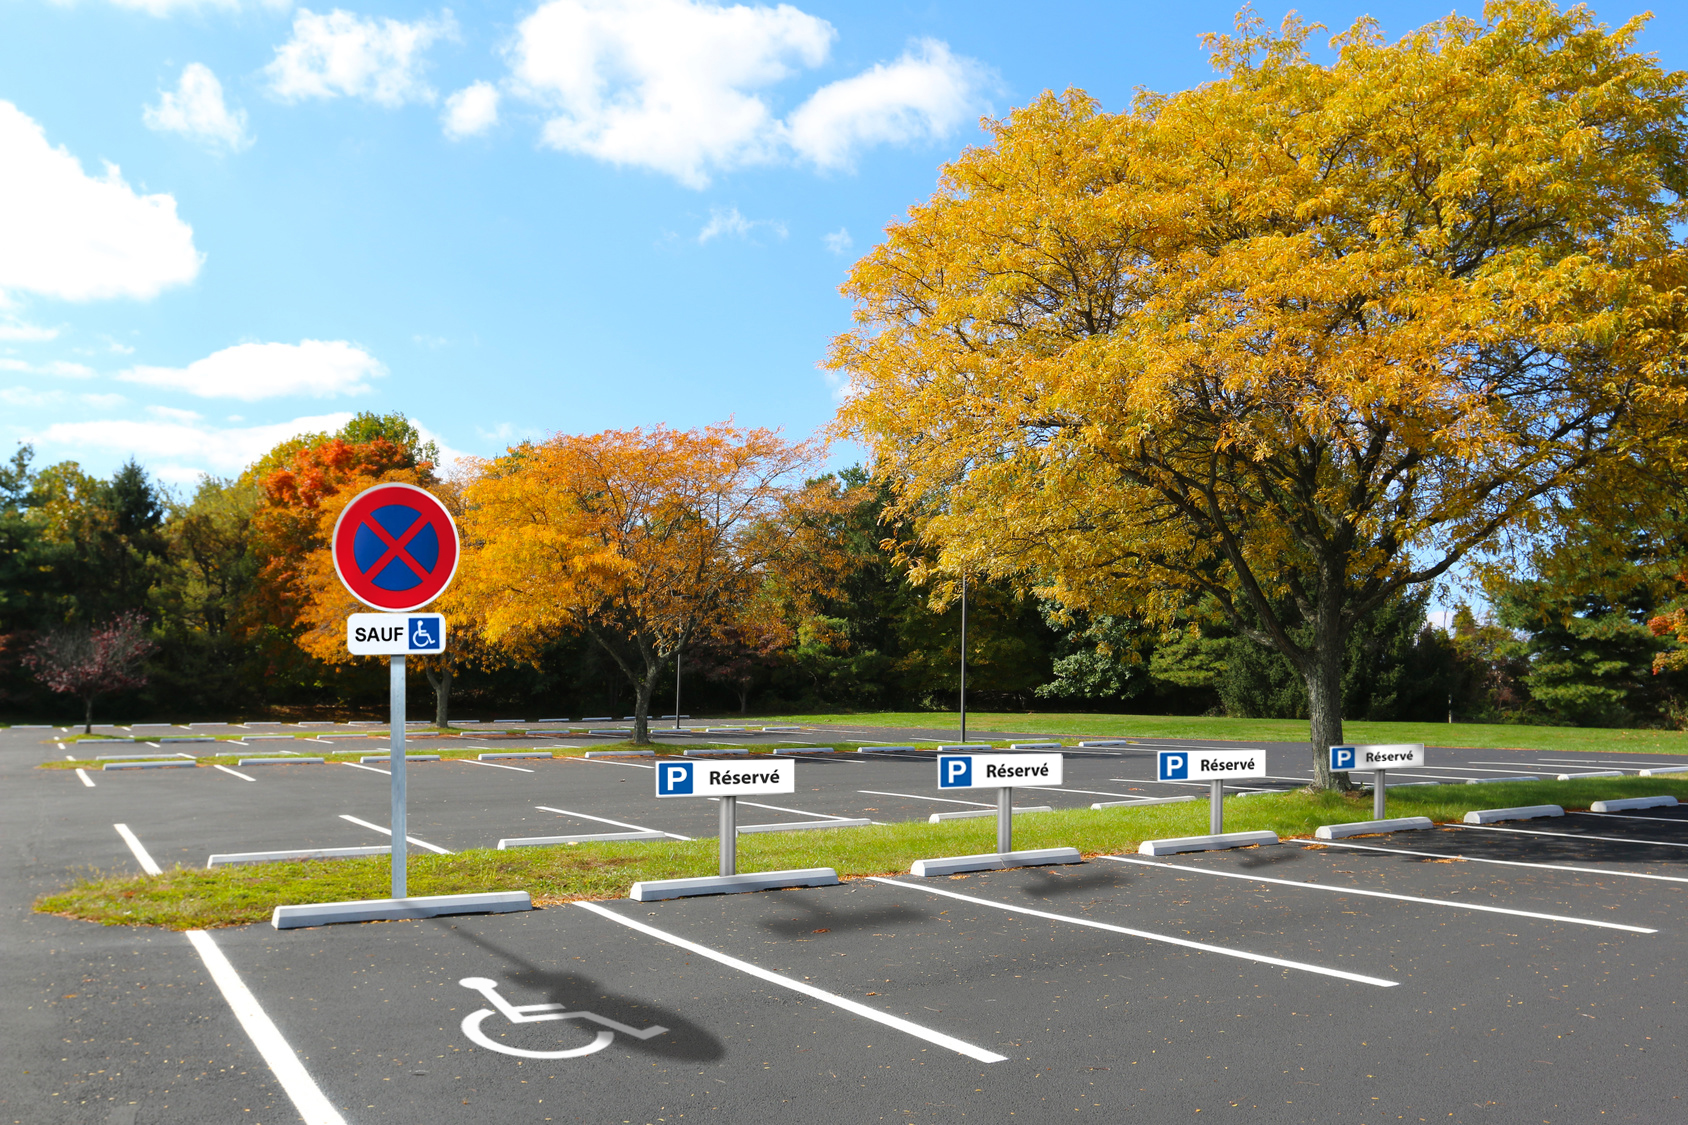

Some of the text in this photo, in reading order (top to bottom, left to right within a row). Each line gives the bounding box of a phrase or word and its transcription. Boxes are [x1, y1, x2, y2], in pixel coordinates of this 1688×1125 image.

[355, 627, 404, 642] SAUF
[1167, 756, 1255, 777] P Réservé
[1337, 750, 1413, 767] P Réservé
[667, 767, 780, 791] P Réservé
[948, 761, 1049, 784] P Réservé
